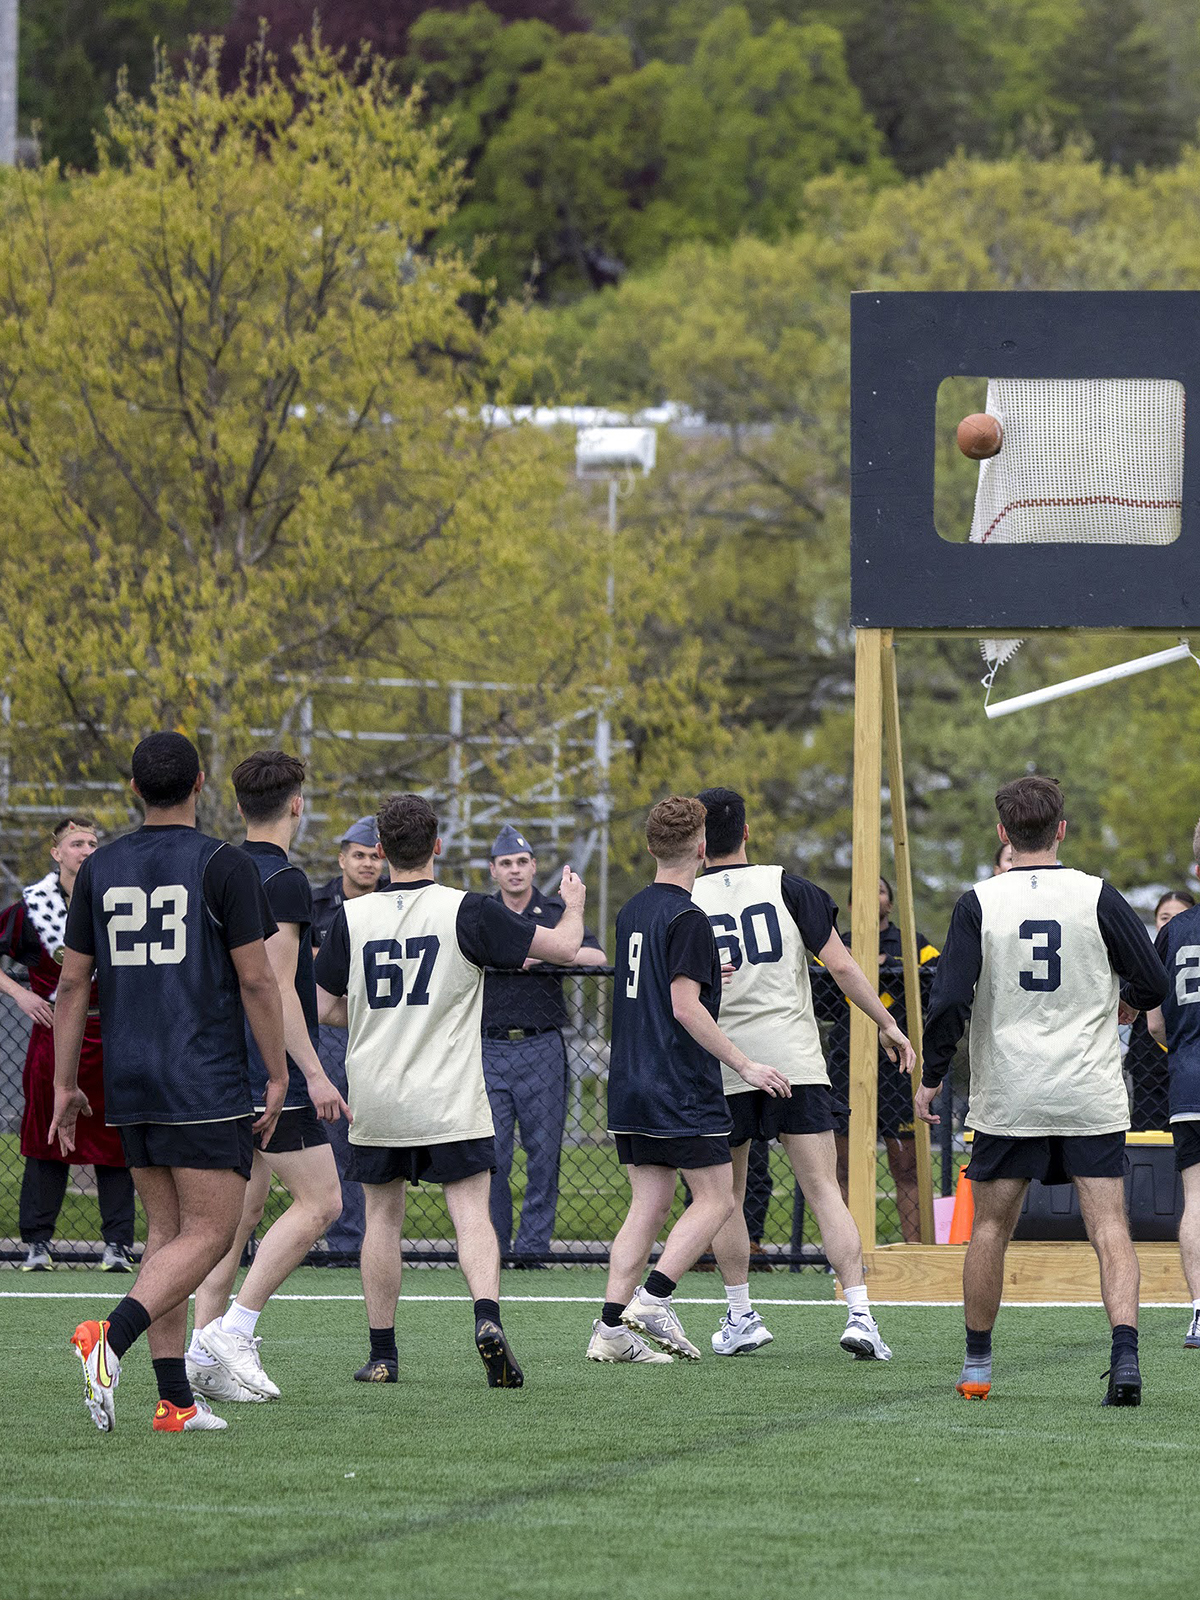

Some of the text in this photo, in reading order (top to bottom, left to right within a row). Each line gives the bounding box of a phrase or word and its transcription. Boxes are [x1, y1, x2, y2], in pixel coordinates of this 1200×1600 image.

[103, 884, 188, 966] 23
[708, 902, 783, 972] 60
[1019, 919, 1061, 992] 3
[362, 934, 441, 1009] 67
[626, 932, 643, 999] 9
